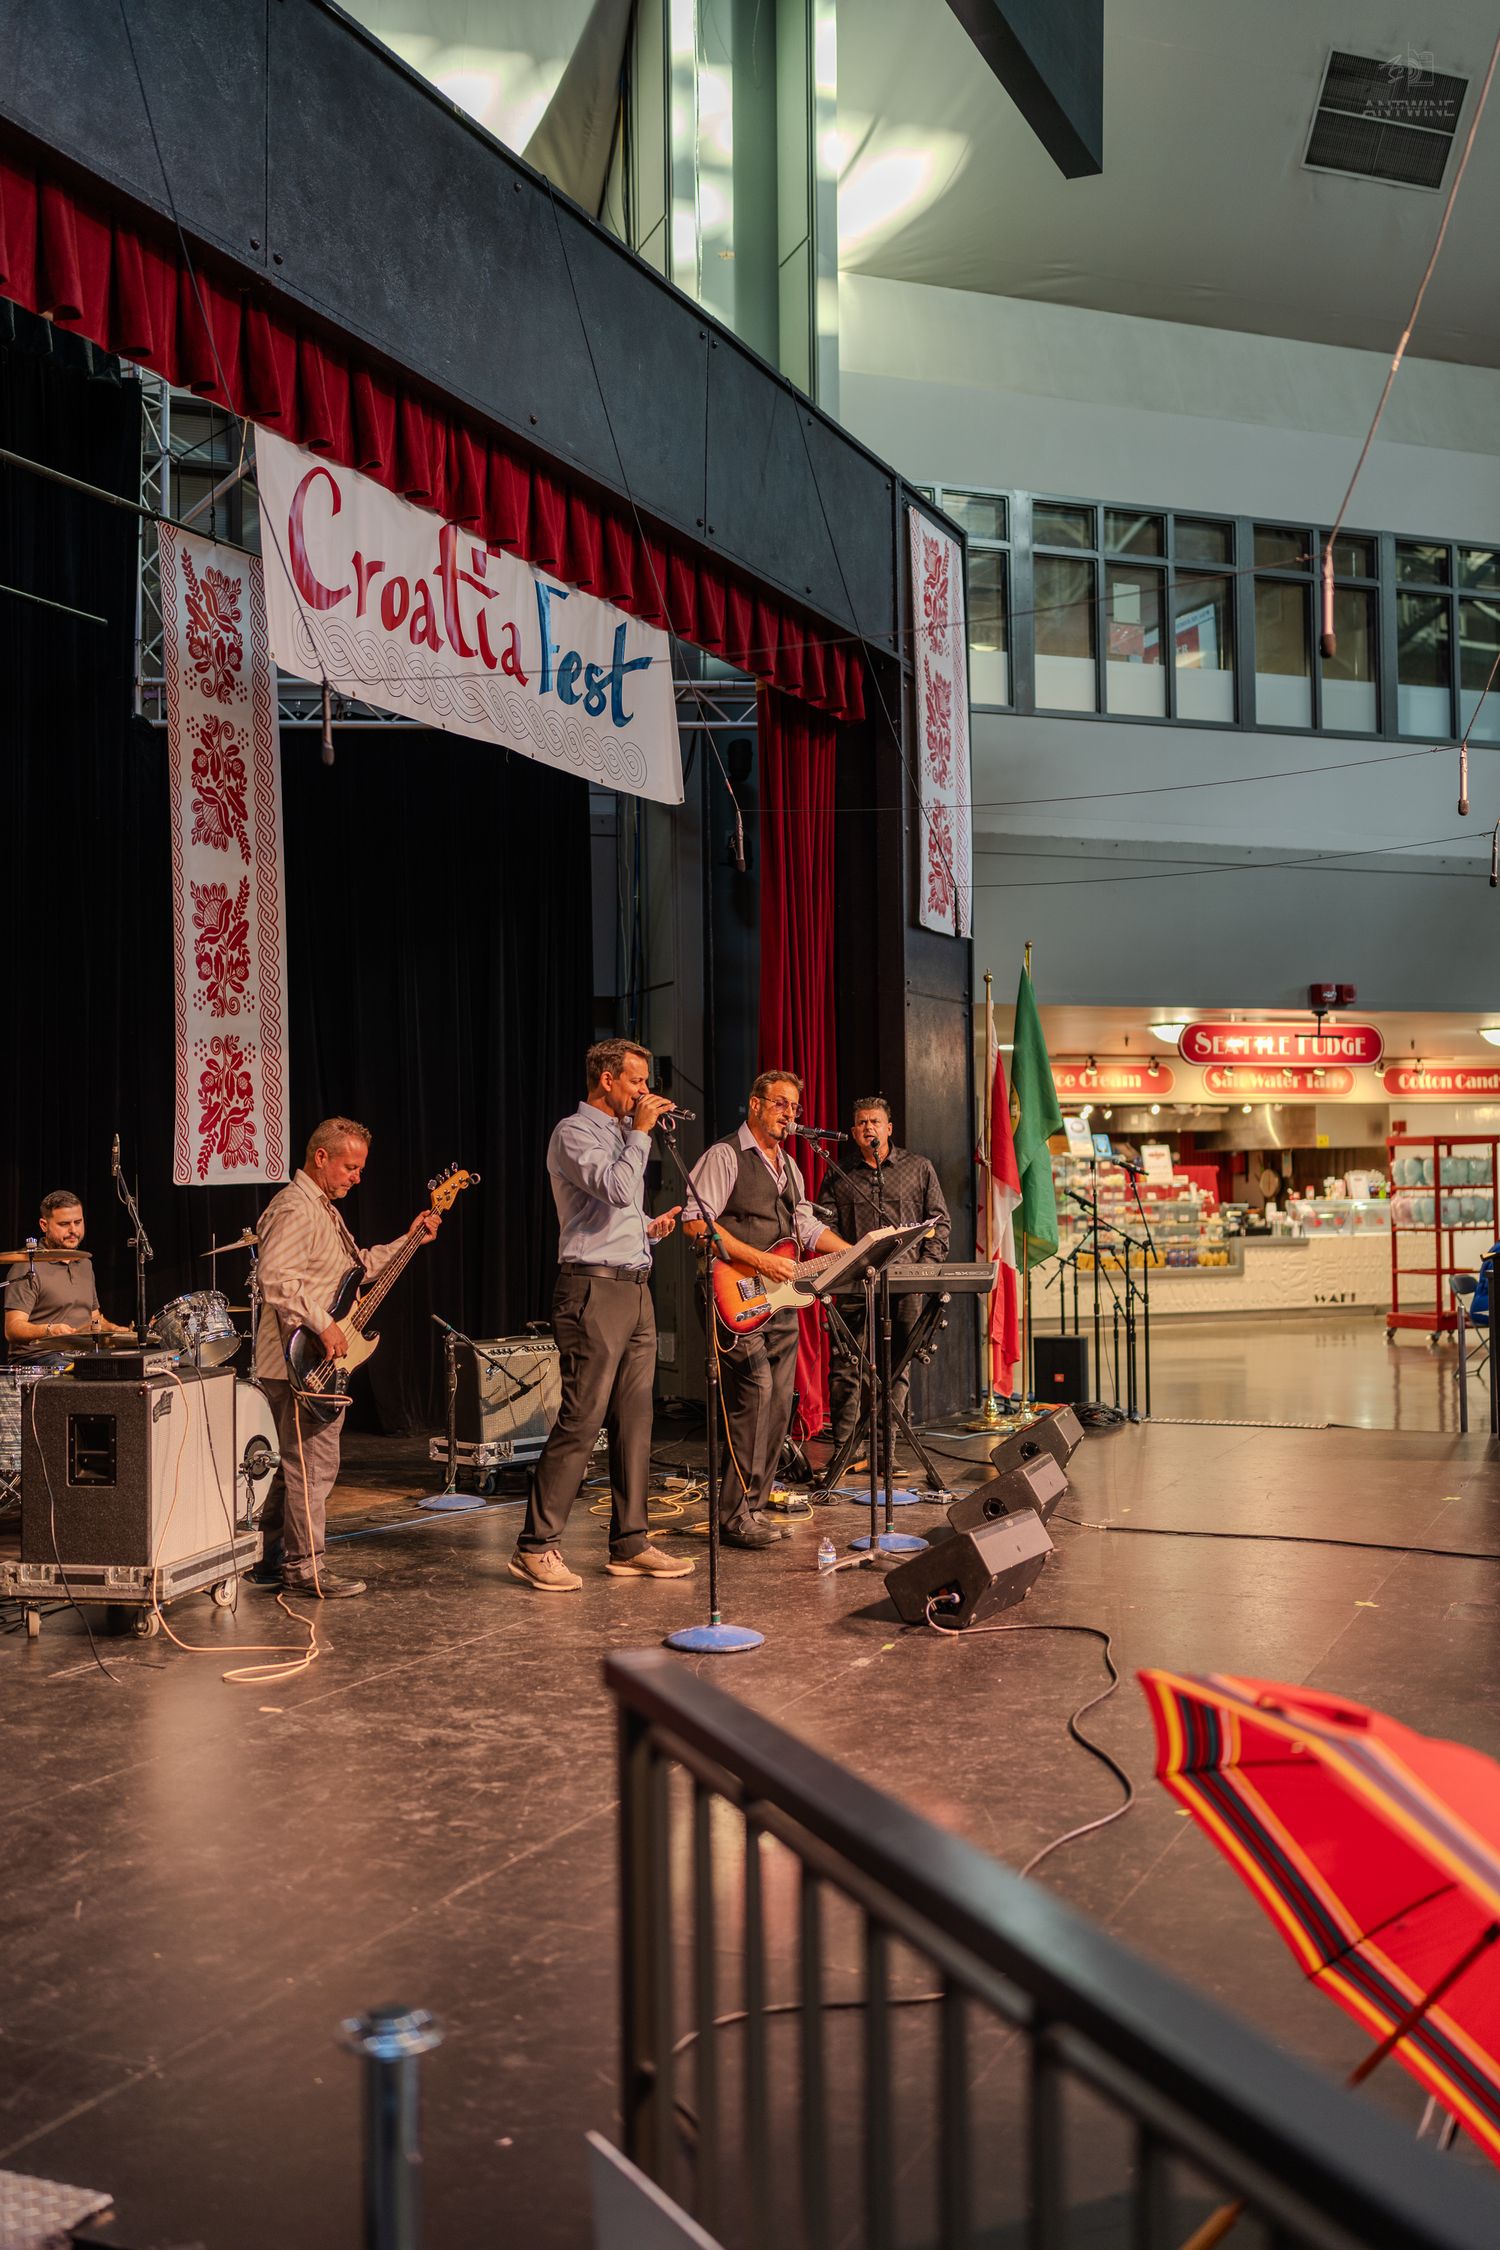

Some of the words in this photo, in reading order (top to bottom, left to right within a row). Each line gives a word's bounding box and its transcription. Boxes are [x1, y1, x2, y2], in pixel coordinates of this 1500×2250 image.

[1194, 1031, 1290, 1056] SEATTLE
[1298, 1034, 1366, 1056] FUDGE
[1054, 1073, 1076, 1088] ce
[1079, 1071, 1142, 1088] Cream
[1248, 1072, 1301, 1089] Water
[1398, 1073, 1452, 1089] Cotton
[1455, 1073, 1500, 1089] Cand
